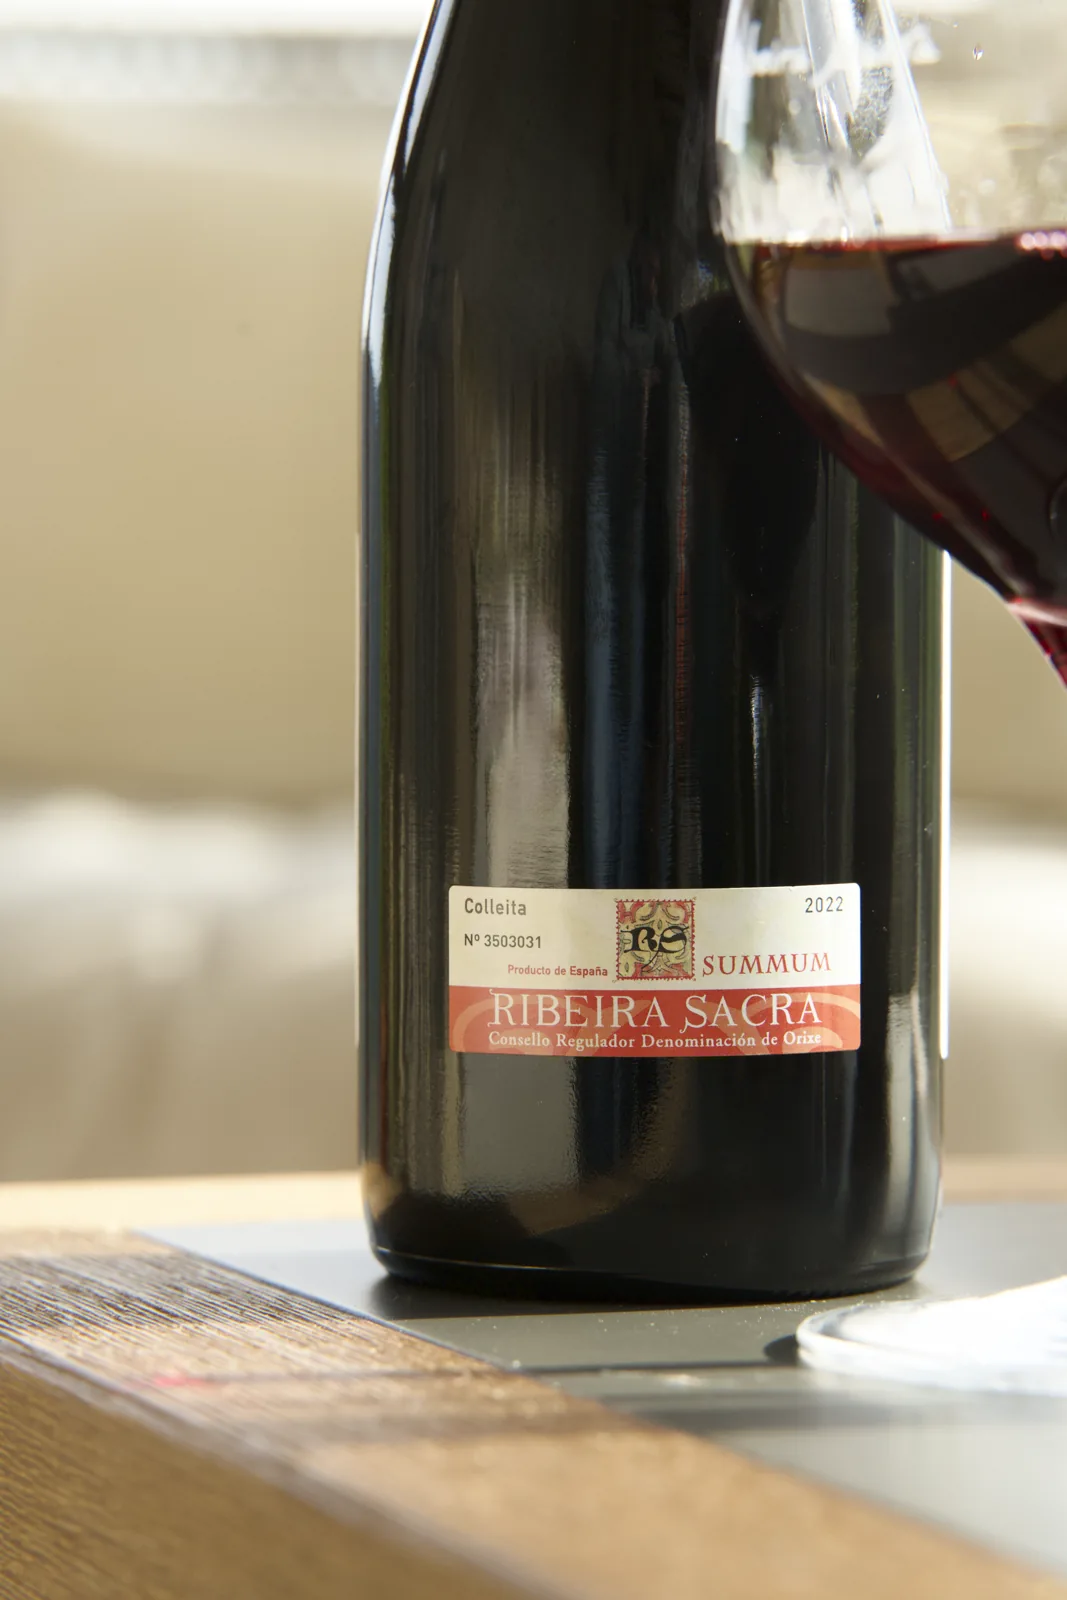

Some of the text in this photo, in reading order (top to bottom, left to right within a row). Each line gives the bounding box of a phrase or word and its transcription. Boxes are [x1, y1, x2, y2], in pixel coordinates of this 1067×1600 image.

[464, 897, 527, 916] Colleita
[805, 896, 844, 914] 2022
[484, 934, 542, 949] 3503031
[507, 964, 608, 978] Producto de España
[702, 952, 832, 977] SUMMUM
[487, 988, 823, 1033] RIBEIRA SACRA
[488, 1030, 822, 1051] Consello Regulador Denominación de Orixe
